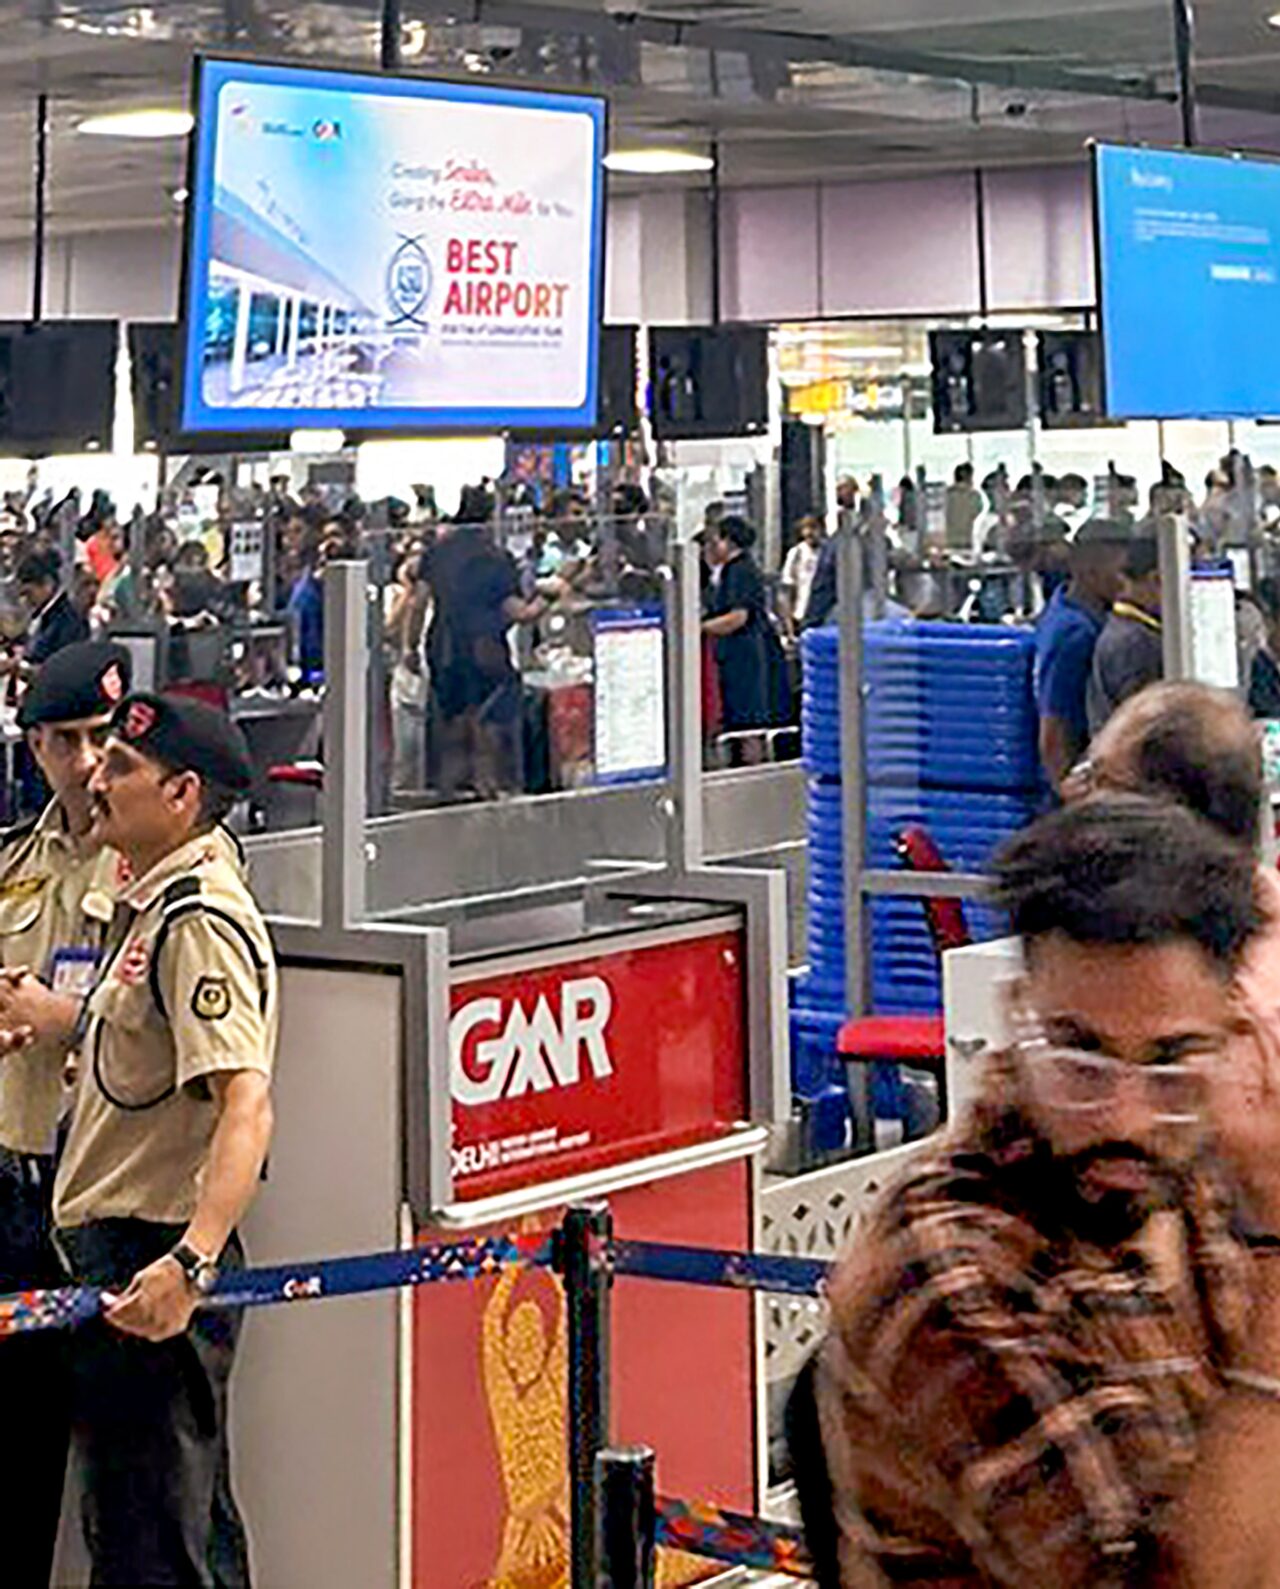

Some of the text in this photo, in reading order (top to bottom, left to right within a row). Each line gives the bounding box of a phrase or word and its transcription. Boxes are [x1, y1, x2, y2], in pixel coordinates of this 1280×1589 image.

[446, 238, 518, 275] BEST
[443, 280, 569, 319] AIRPORT
[450, 976, 613, 1106] GMR
